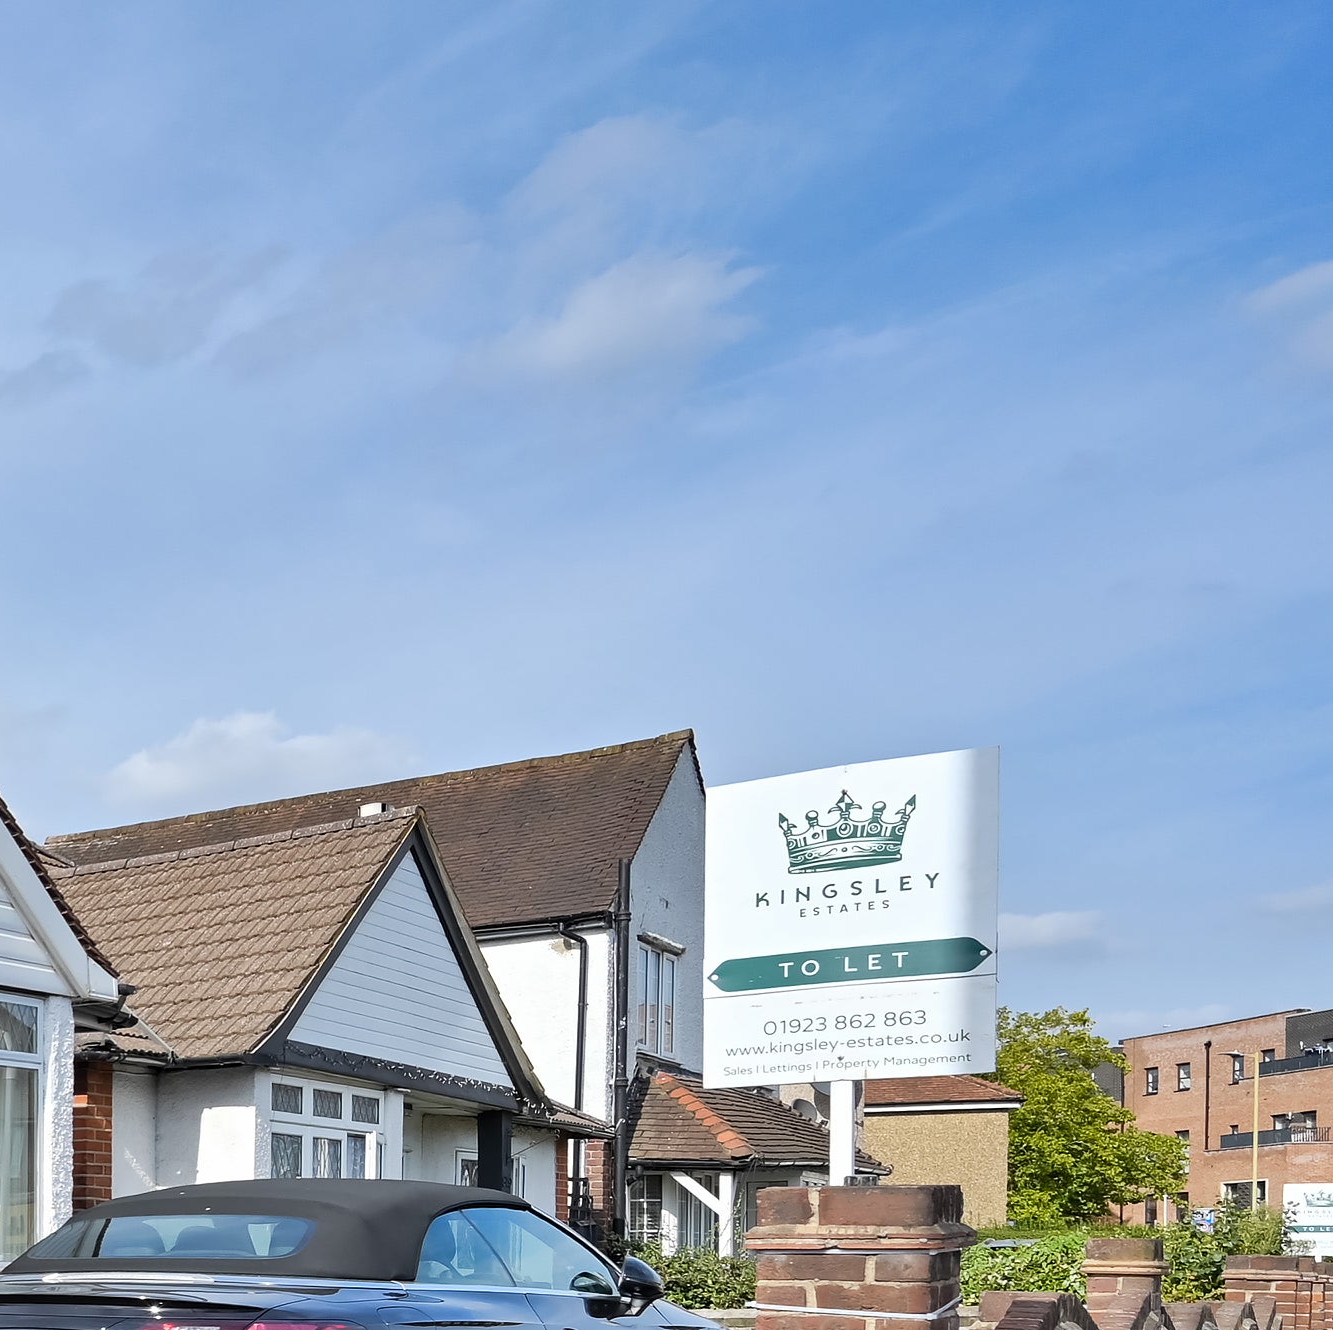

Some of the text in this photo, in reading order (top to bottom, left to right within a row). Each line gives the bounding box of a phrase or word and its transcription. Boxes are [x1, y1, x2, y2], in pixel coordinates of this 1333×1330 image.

[755, 872, 940, 908] KINGSLEY
[799, 899, 890, 918] ESTATES
[778, 951, 909, 978] TO LET
[763, 1009, 927, 1036] 01923 862 863
[725, 1029, 971, 1057] www.kingsley-estates.co.uk
[723, 1066, 753, 1077] Sales
[763, 1062, 812, 1075] Lettings
[822, 1059, 879, 1072] Property
[883, 1053, 972, 1067] Management
